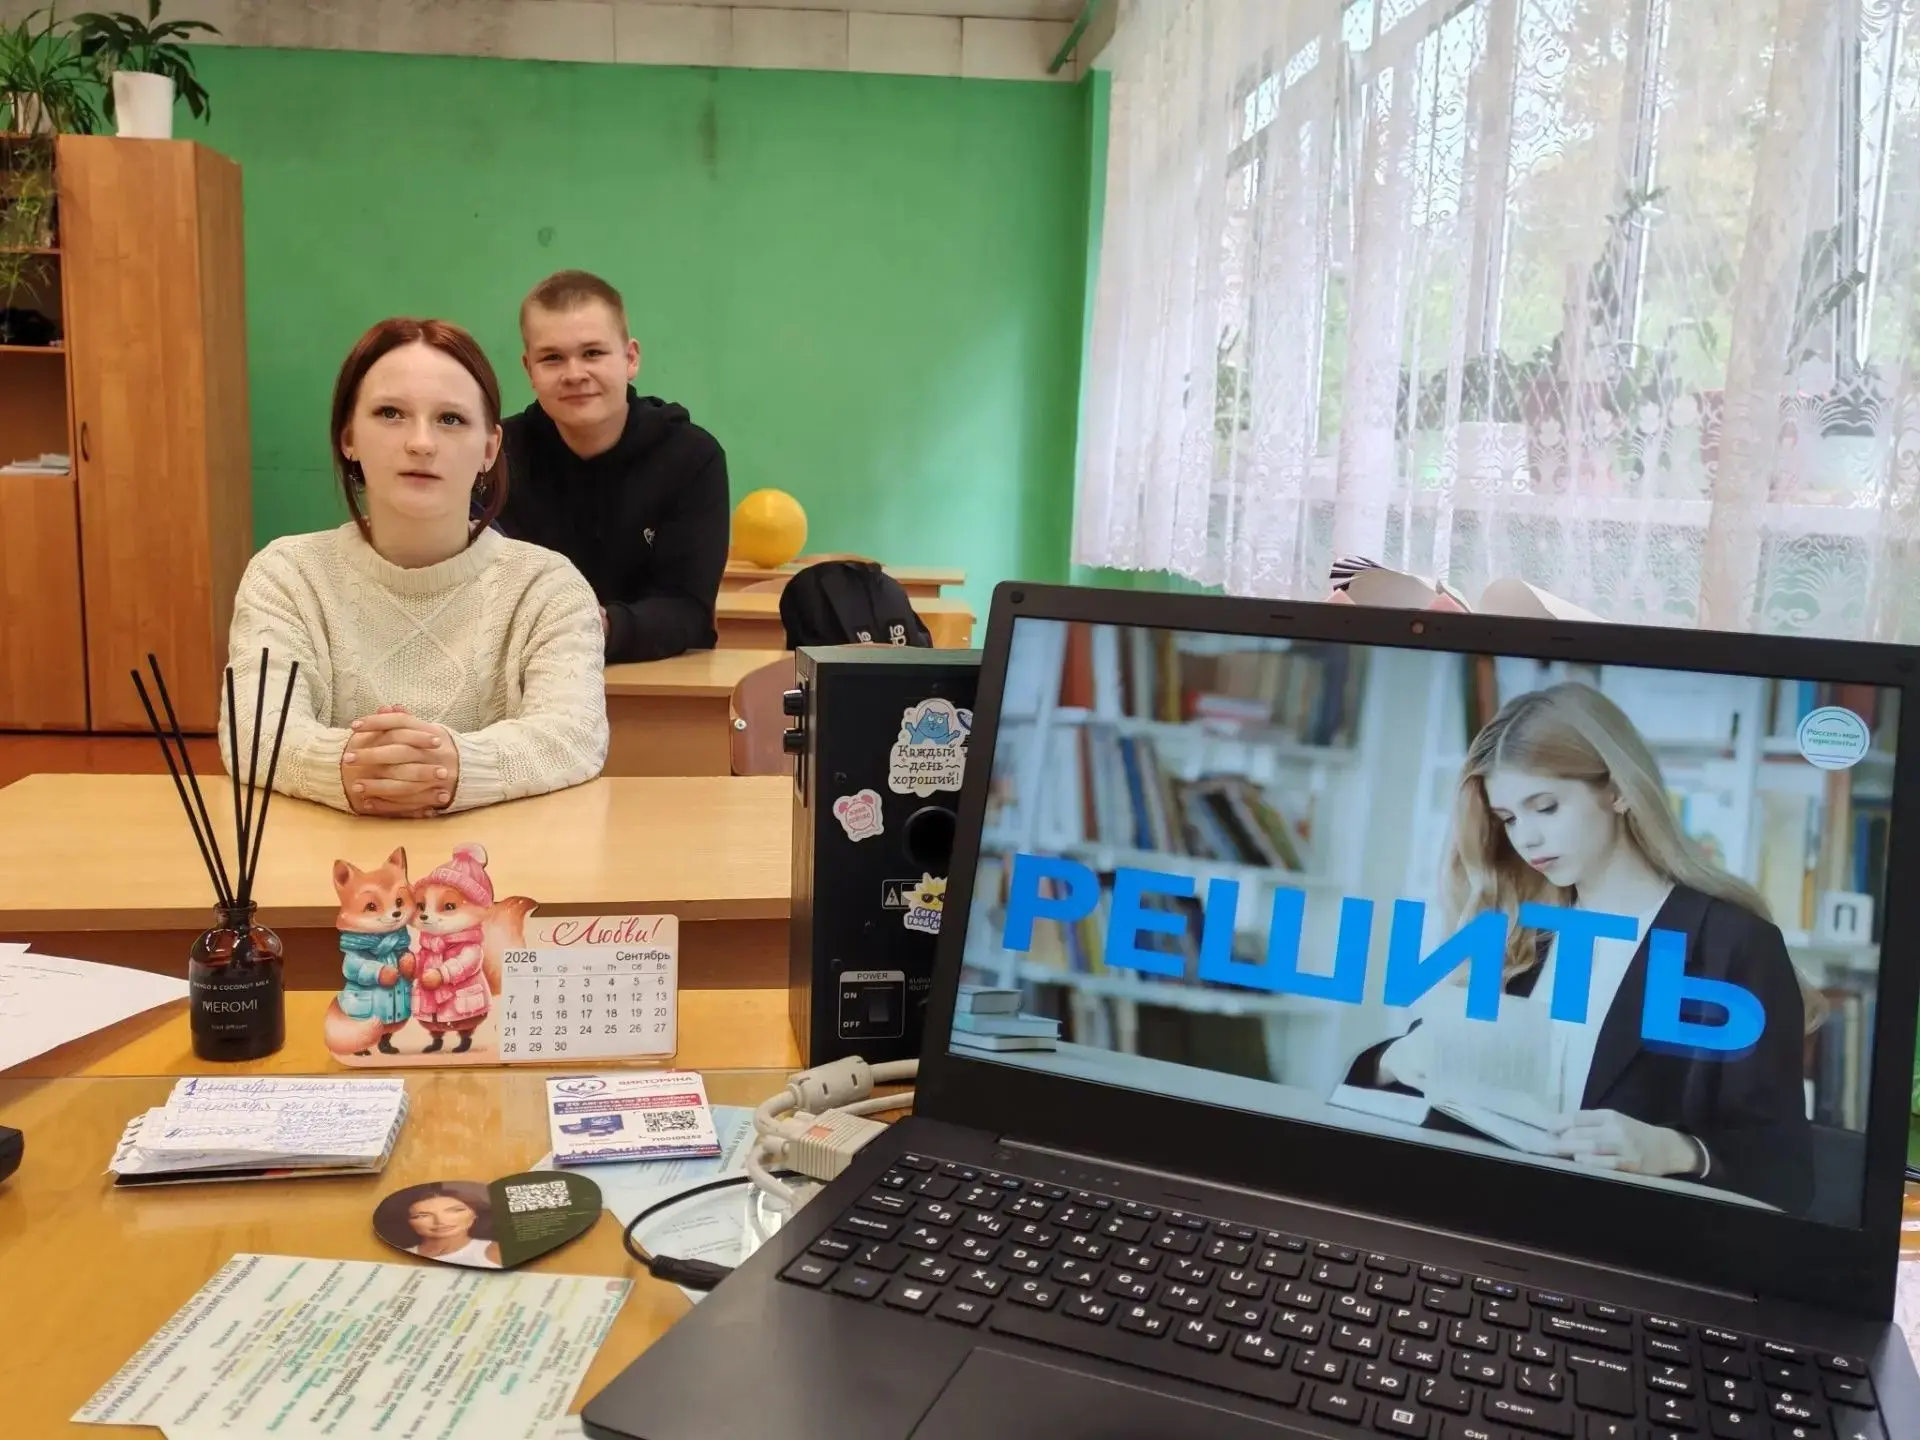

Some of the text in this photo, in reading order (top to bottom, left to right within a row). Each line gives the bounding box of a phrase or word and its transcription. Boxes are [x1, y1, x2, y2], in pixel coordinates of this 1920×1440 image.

[898, 744, 956, 759] Каждый
[909, 761, 944, 772] день
[893, 772, 959, 789] хороший!
[545, 917, 664, 946] Любви!
[504, 952, 537, 963] 2026
[616, 951, 670, 961] Сентябрь
[1002, 854, 1766, 1053] РЕШИТЬ
[219, 982, 254, 991] COCONUT
[255, 979, 270, 987] MILK
[535, 977, 664, 988] 1 2 3 4 5 6
[508, 996, 515, 1004] 7
[559, 995, 565, 1003] 9
[582, 995, 592, 1003] 10
[607, 994, 617, 1002] 11
[632, 993, 642, 1002] 12
[202, 999, 258, 1013] MEROMI
[506, 1008, 666, 1020] 14 15 16 17 18 19 20
[505, 1028, 515, 1036] 21
[530, 1027, 542, 1035] 22
[555, 1026, 567, 1035] 23
[580, 1026, 592, 1034] 24
[605, 1025, 617, 1033] 25
[655, 1024, 665, 1032] 27
[504, 1042, 567, 1052] 28 29 30
[618, 1076, 693, 1086] ВИКТОРИНА
[978, 1215, 993, 1225] W
[1024, 1225, 1036, 1233] E
[1074, 1236, 1086, 1244] R
[921, 1258, 934, 1266] Z
[1231, 1272, 1242, 1280] U
[1024, 1282, 1036, 1290] C
[1172, 1287, 1185, 1295] H
[1081, 1295, 1092, 1303] V
[1298, 1294, 1311, 1302] Ш
[1342, 1297, 1355, 1305] O
[1090, 1306, 1104, 1314] М
[1133, 1308, 1144, 1316] B
[1356, 1306, 1370, 1316] Щ
[1284, 1313, 1296, 1322] K
[1147, 1320, 1158, 1328] И
[1189, 1322, 1202, 1331] N
[1302, 1325, 1313, 1333] Л
[1552, 1318, 1608, 1333] Backspace
[1342, 1326, 1351, 1335] L
[1246, 1335, 1261, 1345] M
[1359, 1338, 1370, 1347] Д
[1534, 1348, 1546, 1356] Ъ
[1765, 1342, 1795, 1353] Pause
[1417, 1352, 1432, 1361] Ж
[1324, 1364, 1335, 1372] Б
[1598, 1360, 1628, 1372] Enter
[1381, 1377, 1397, 1387] Ю
[1652, 1376, 1688, 1390] Home
[1510, 1405, 1535, 1416] Shift
[1776, 1403, 1811, 1418] PgUp
[1464, 1429, 1489, 1440] Ctrl
[1794, 1429, 1804, 1437] 6
